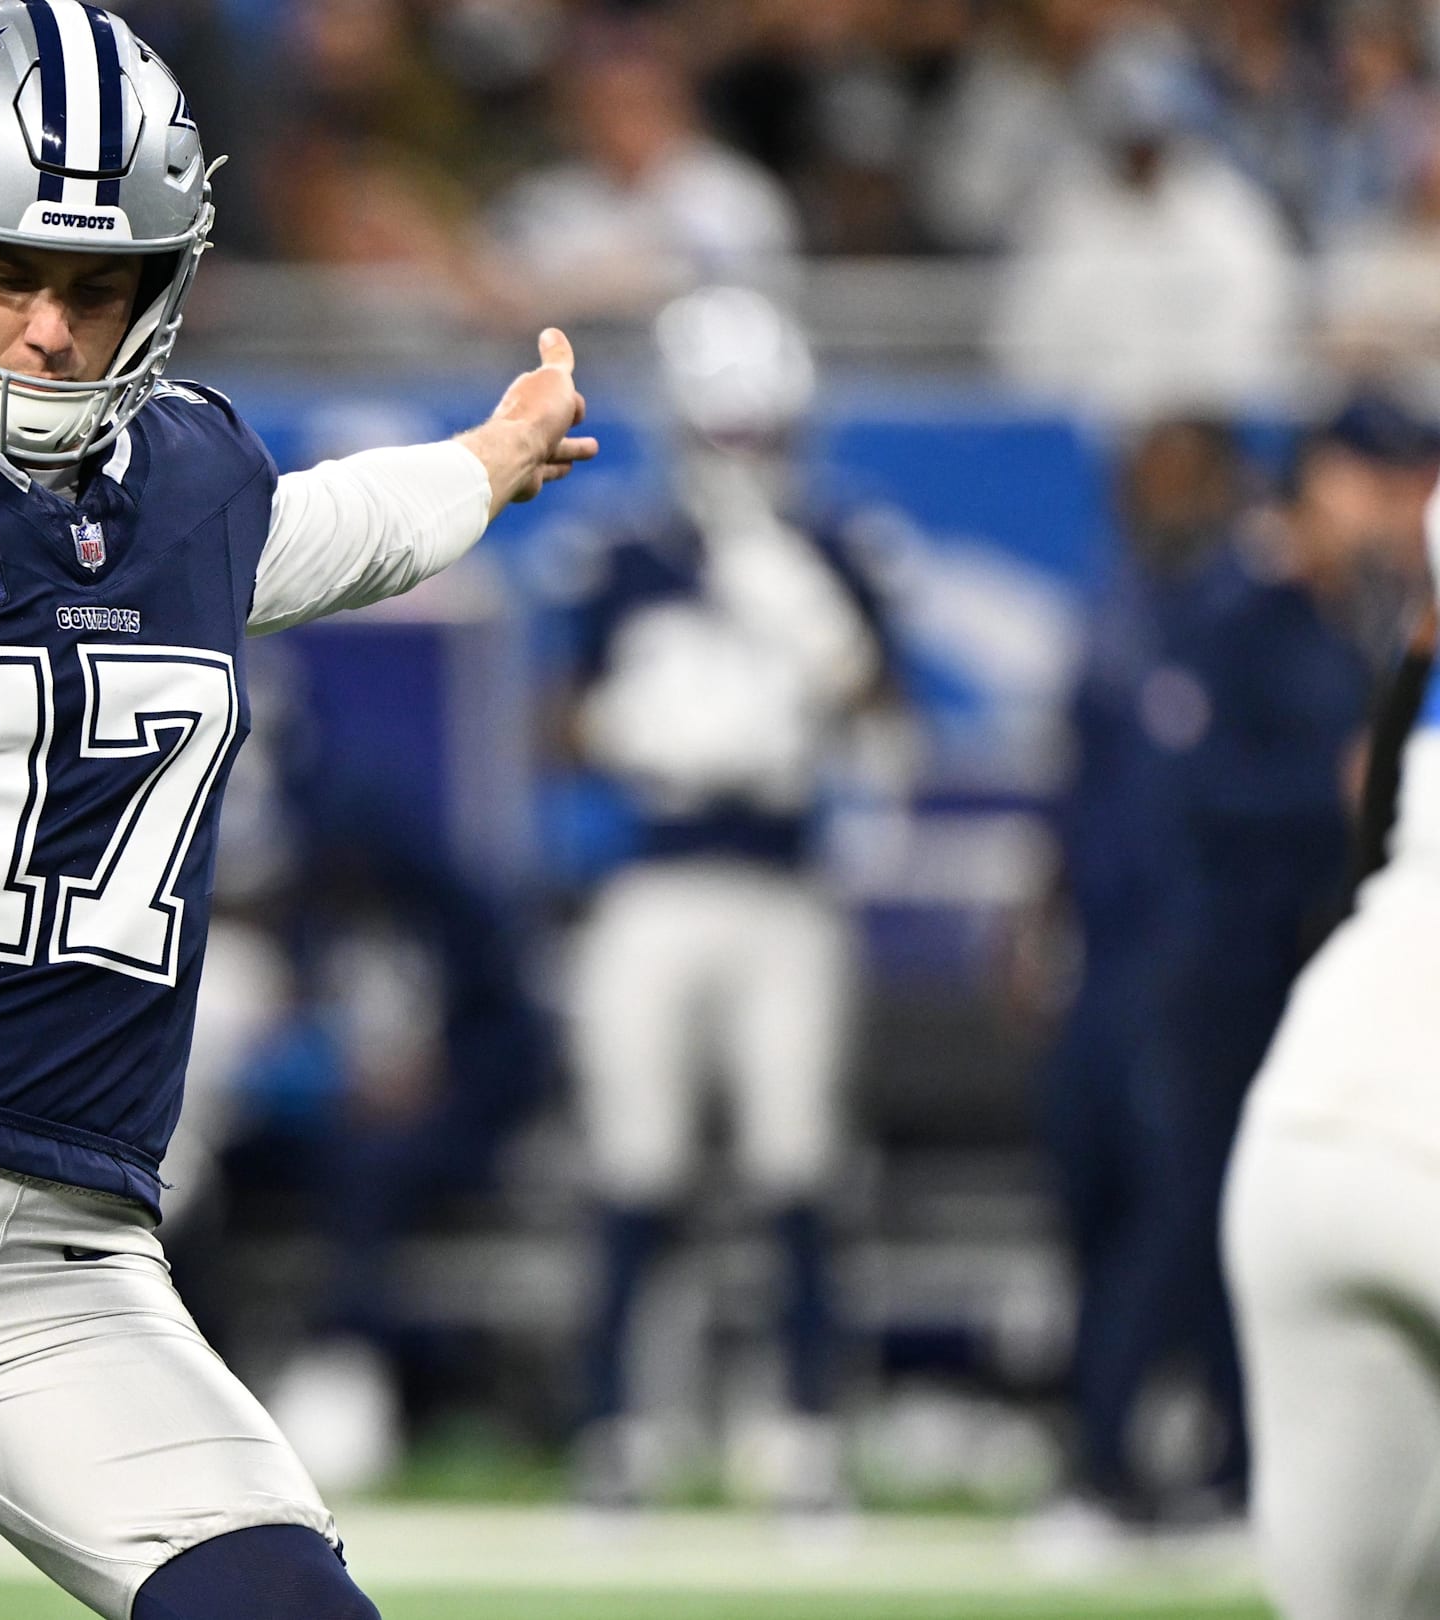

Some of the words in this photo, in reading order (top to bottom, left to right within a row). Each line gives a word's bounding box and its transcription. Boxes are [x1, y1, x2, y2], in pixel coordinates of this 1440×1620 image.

[41, 211, 115, 230] COWBOYS
[80, 541, 103, 562] NFL
[56, 606, 141, 633] COWBOYS
